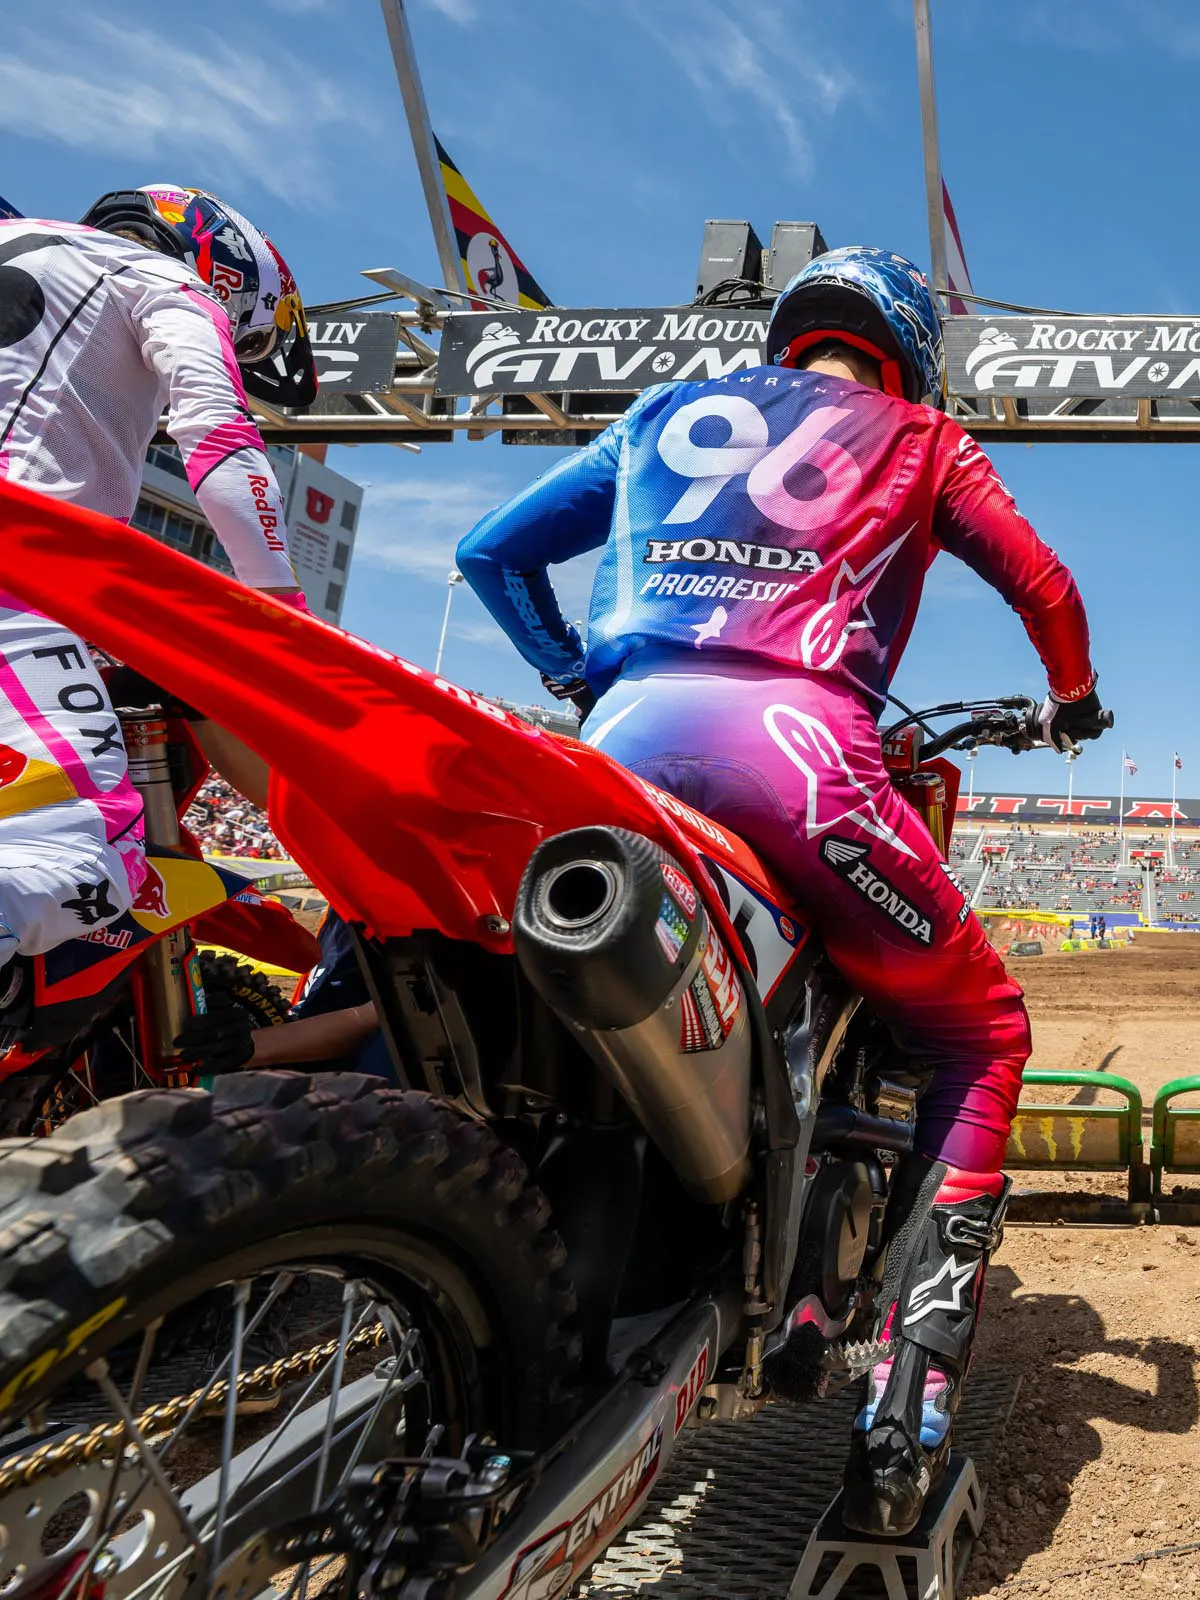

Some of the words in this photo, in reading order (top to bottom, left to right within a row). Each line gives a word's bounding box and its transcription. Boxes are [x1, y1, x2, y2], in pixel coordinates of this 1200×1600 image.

[284, 322, 367, 344] AIN
[528, 316, 648, 343] ROCKY
[652, 314, 769, 343] MOUN
[1024, 324, 1142, 351] ROCKY
[679, 347, 766, 381] M
[657, 395, 863, 532] 96
[247, 474, 276, 512] Red
[258, 514, 285, 552] Bull
[646, 538, 824, 573] HONDA
[640, 573, 800, 602] PROGRESSI
[32, 644, 125, 758] FOX
[635, 776, 734, 853] HONDA
[847, 862, 931, 943] HONDA
[239, 986, 285, 1026] DUNLO
